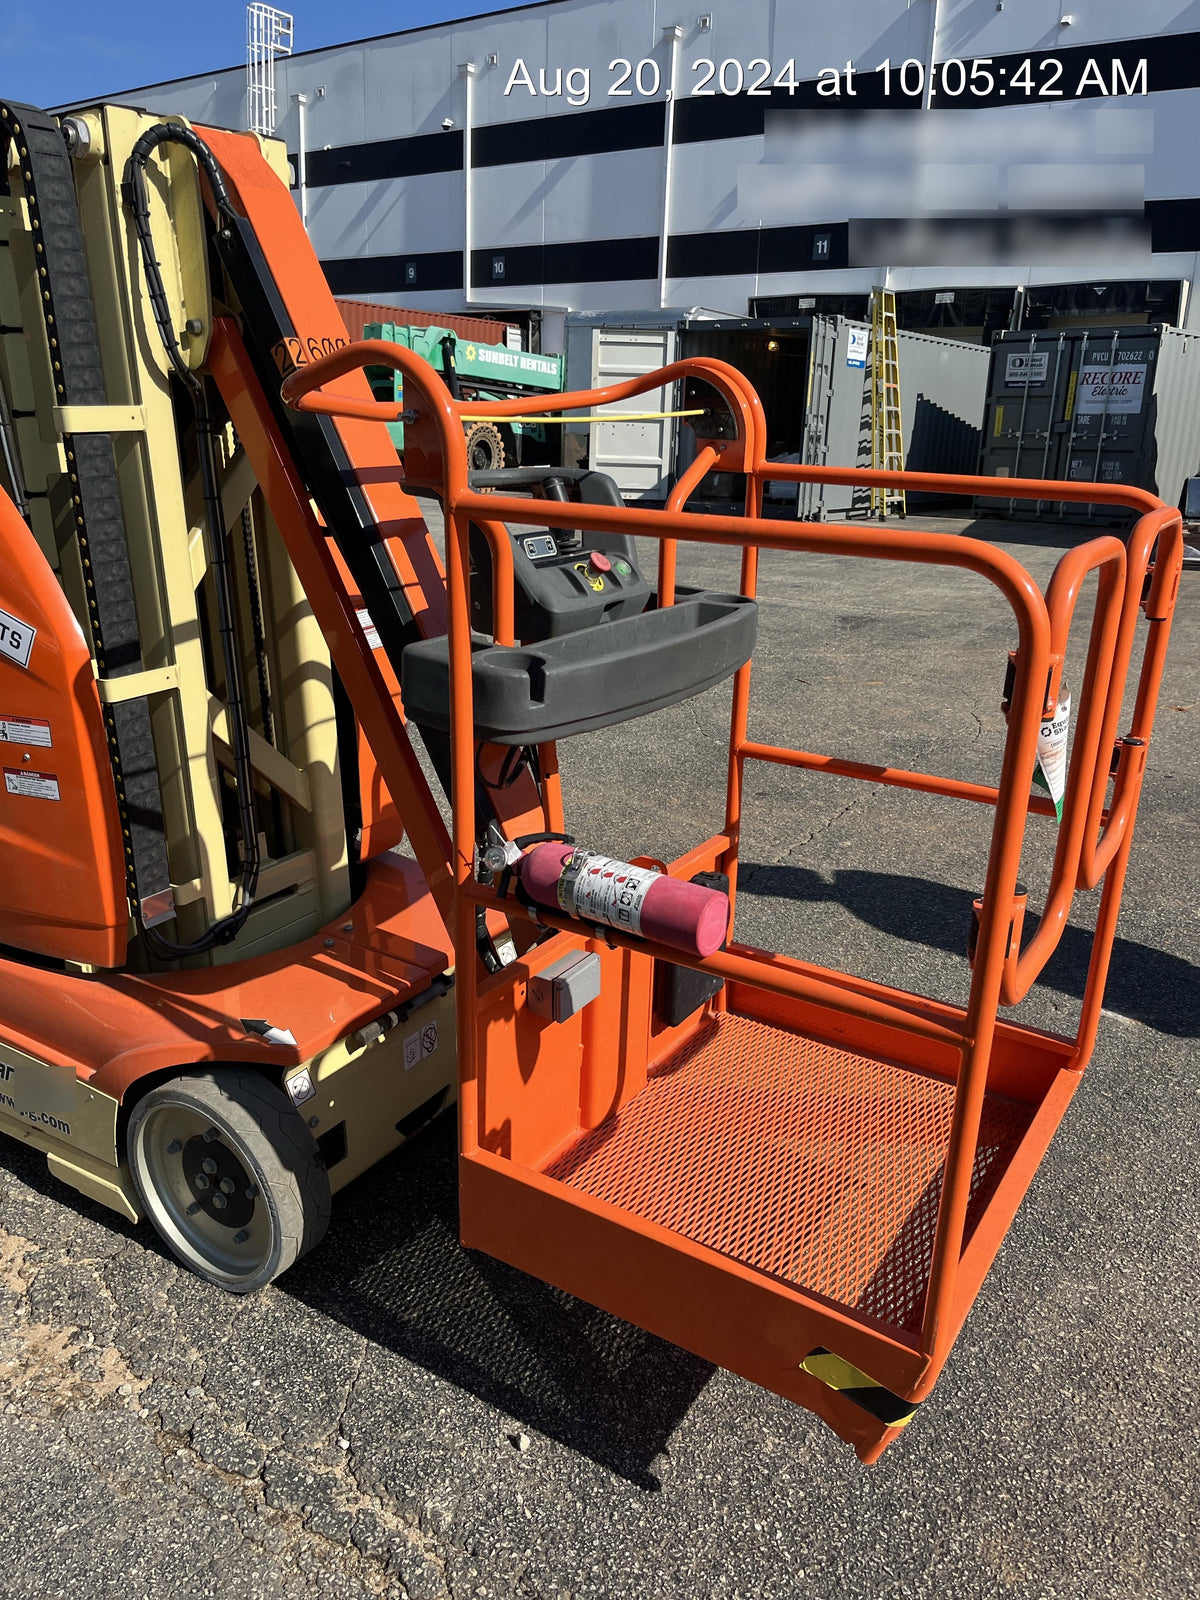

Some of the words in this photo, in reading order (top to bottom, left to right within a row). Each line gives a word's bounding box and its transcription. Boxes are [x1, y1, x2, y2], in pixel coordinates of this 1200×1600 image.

[816, 240, 828, 254] 11
[408, 267, 415, 279] 9
[494, 262, 504, 274] 10
[478, 348, 519, 368] SUNBELT
[520, 356, 558, 375] RENTALS
[1092, 352, 1109, 362] PVCU
[1117, 351, 1143, 361] 702622
[1080, 371, 1145, 385] RECORE
